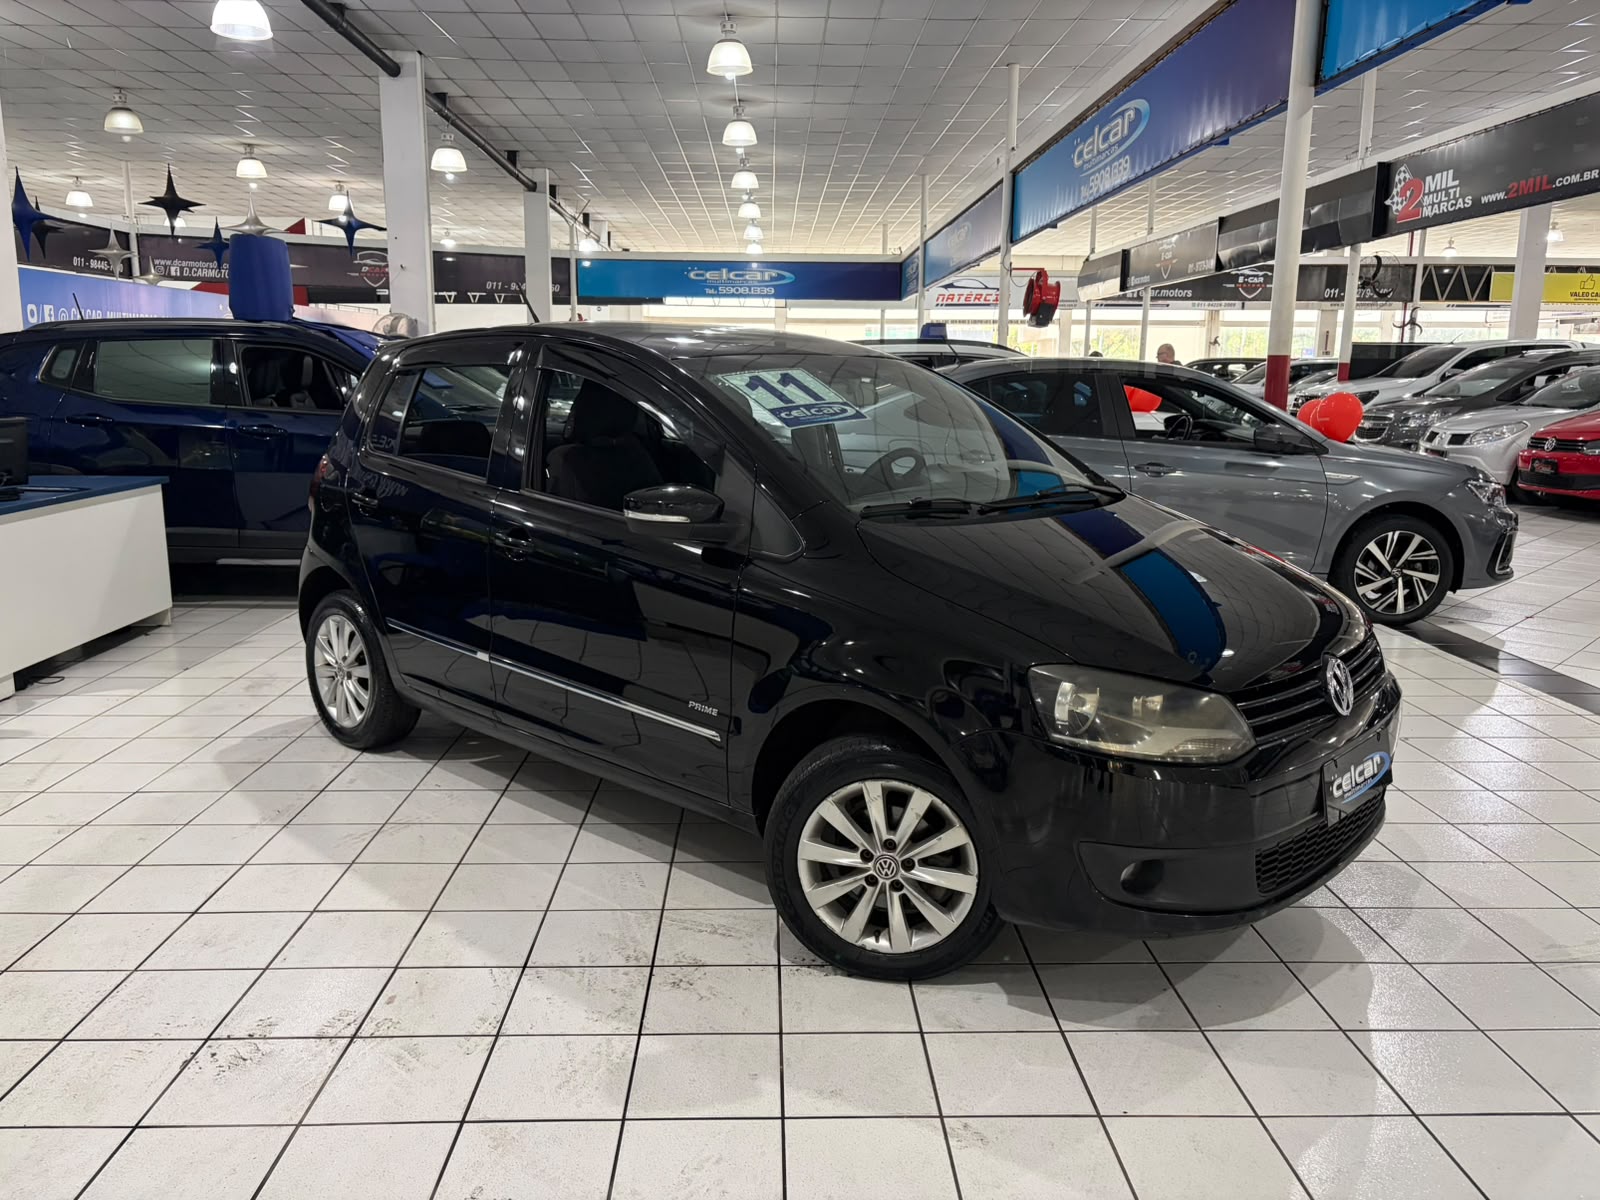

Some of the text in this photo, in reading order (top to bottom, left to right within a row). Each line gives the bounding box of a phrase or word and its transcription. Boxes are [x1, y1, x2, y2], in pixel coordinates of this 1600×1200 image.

[1073, 107, 1136, 168] celcar
[1396, 169, 1459, 223] 2 MIL
[1424, 187, 1460, 206] MULTI
[1423, 196, 1473, 218] MARCAS
[73, 257, 84, 267] 011
[688, 268, 777, 280] celcar
[486, 281, 502, 290] 011
[1324, 288, 1339, 298] 011
[745, 372, 826, 405] 11
[780, 404, 842, 420] celcar
[688, 700, 719, 717] PRIME
[1332, 754, 1381, 798] celcar
